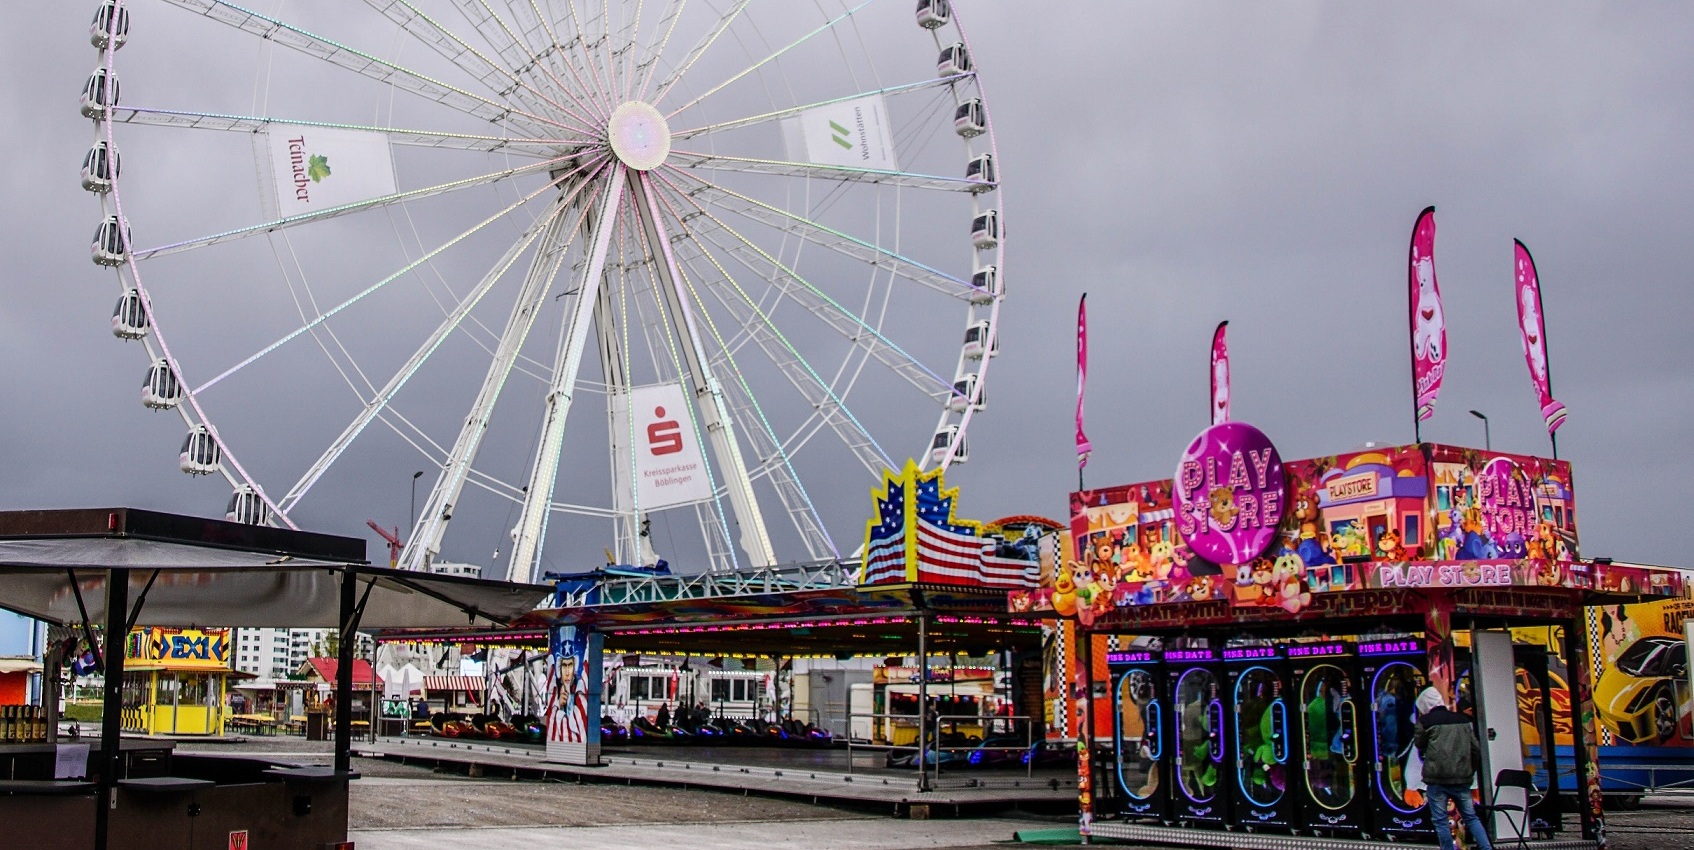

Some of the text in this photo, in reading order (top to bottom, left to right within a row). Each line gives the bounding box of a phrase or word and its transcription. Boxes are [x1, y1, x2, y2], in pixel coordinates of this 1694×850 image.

[288, 135, 310, 203] Teinacher
[644, 463, 697, 477] Kreissparkasse
[1183, 447, 1271, 498] PLAY
[655, 475, 692, 487] Böblingen
[1329, 478, 1373, 498] PLAYSTORE
[1480, 474, 1531, 507] PLAY
[1380, 565, 1433, 587] PLAY
[1343, 589, 1406, 610] TEDDY
[1245, 648, 1274, 657] DATE
[1312, 645, 1342, 655] DATE
[1384, 641, 1417, 651] DATE
[1124, 652, 1150, 661] DATE
[1185, 650, 1212, 659] DATE
